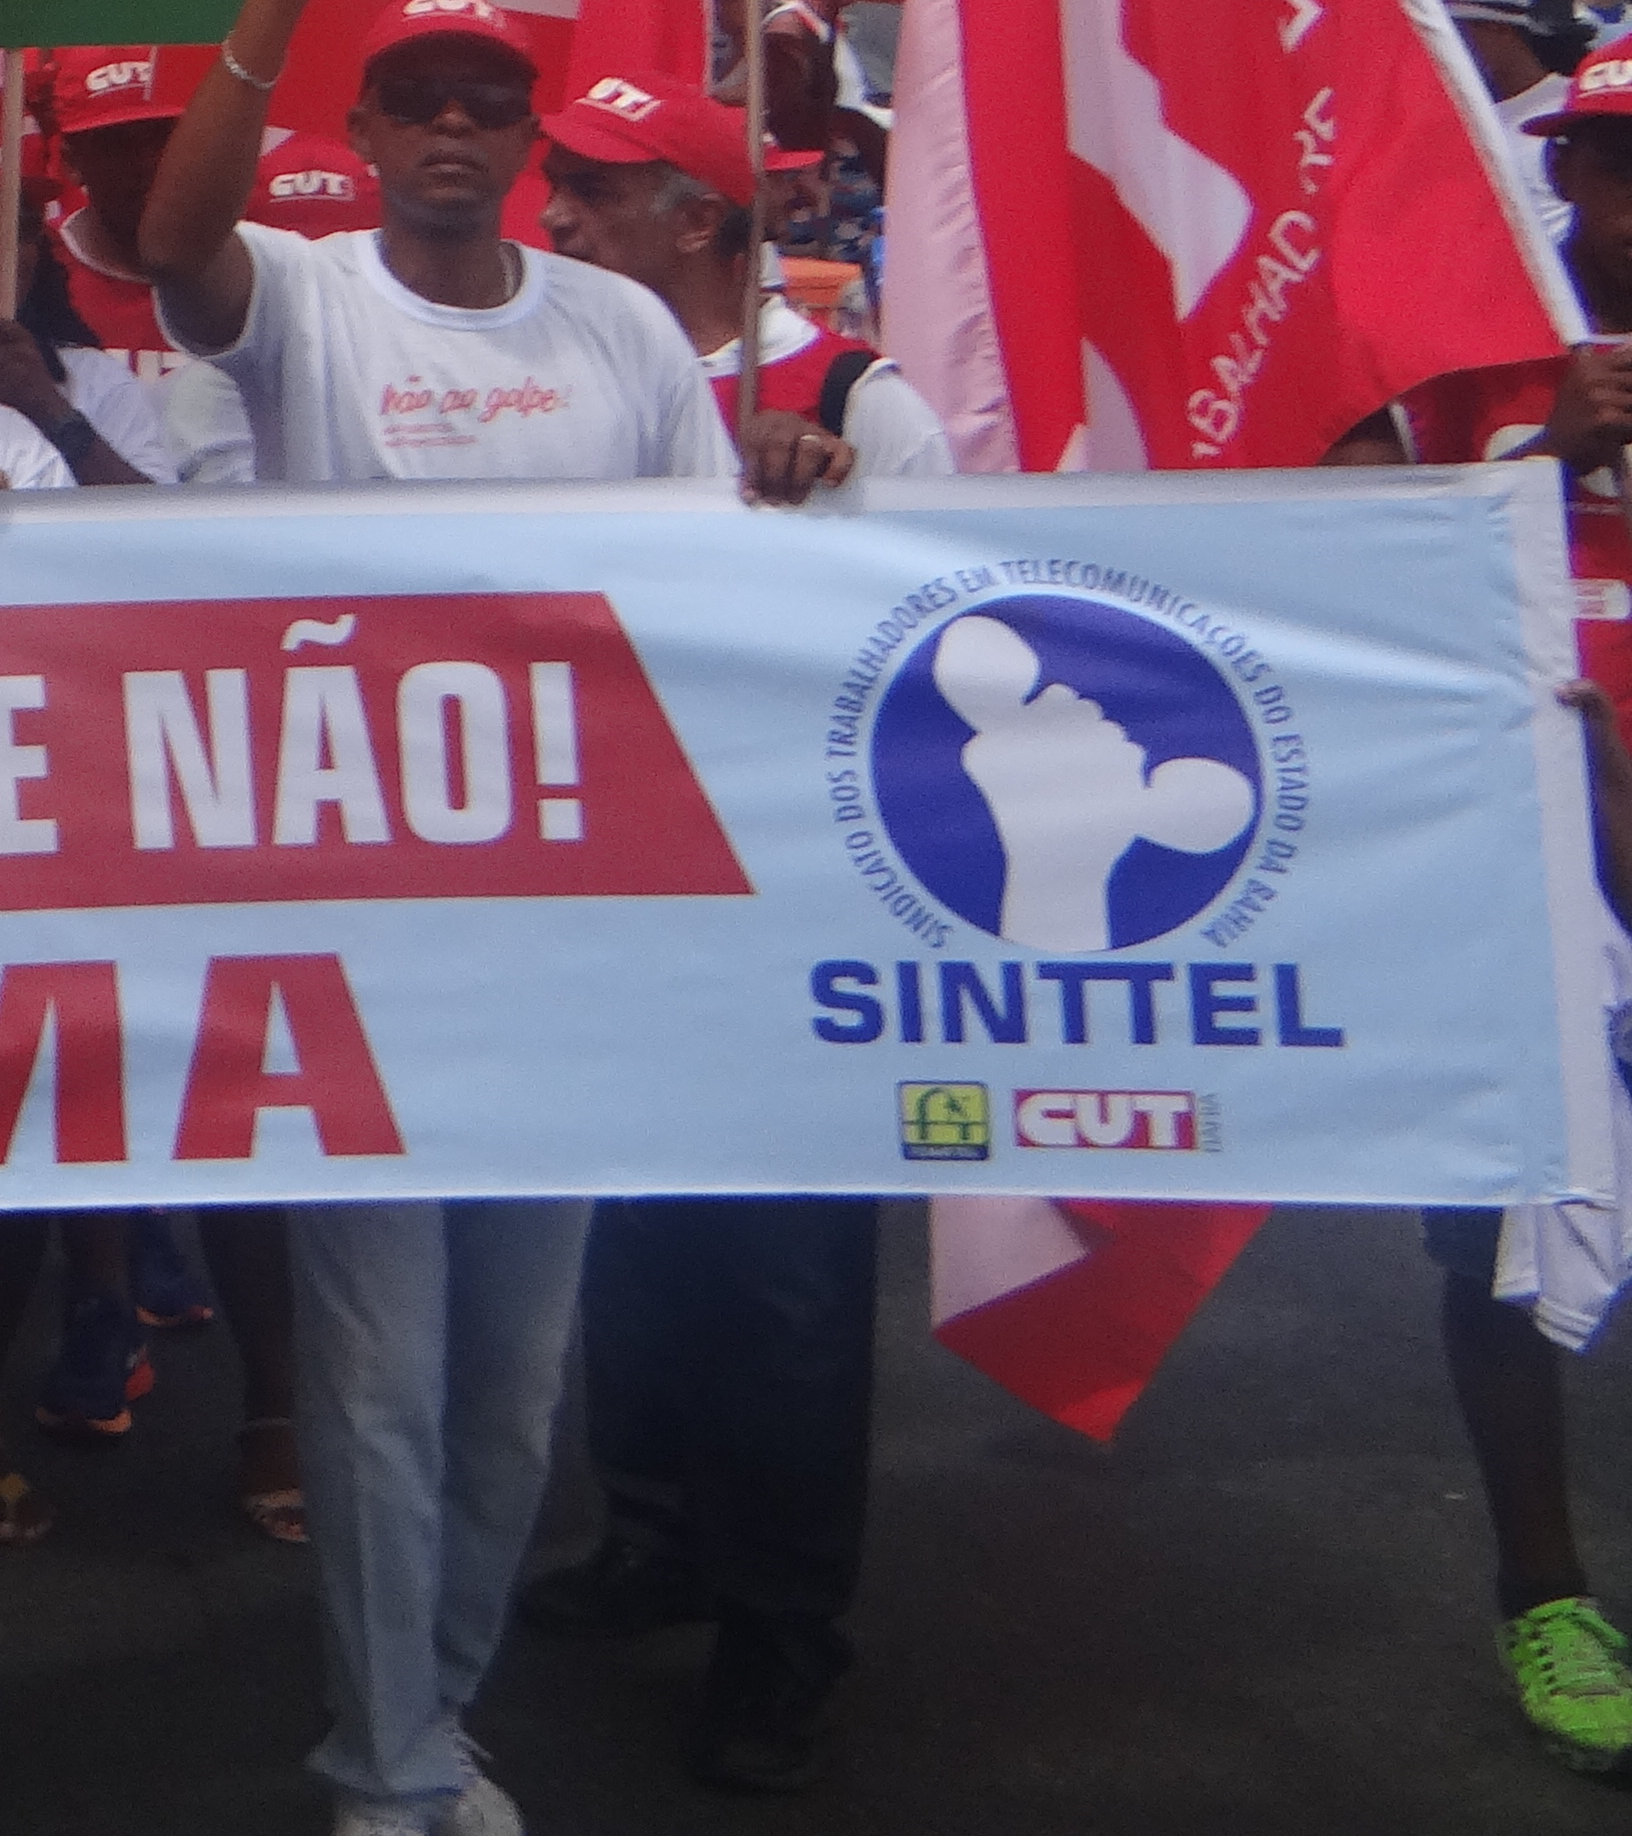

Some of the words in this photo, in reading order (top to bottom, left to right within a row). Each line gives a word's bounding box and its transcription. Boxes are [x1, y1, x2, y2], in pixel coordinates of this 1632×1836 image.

[87, 61, 154, 92] CUT
[269, 169, 346, 197] CUT
[826, 577, 958, 760] TRABALHADORES
[122, 612, 584, 851] NÃO!
[1254, 684, 1292, 724] DO
[826, 769, 865, 822] DOS
[1272, 734, 1309, 831] ESTADO
[1258, 838, 1297, 874] DA
[845, 831, 954, 948] SINDICATO
[810, 961, 1346, 1049] SINTTEL
[1017, 1092, 1193, 1148] CUT
